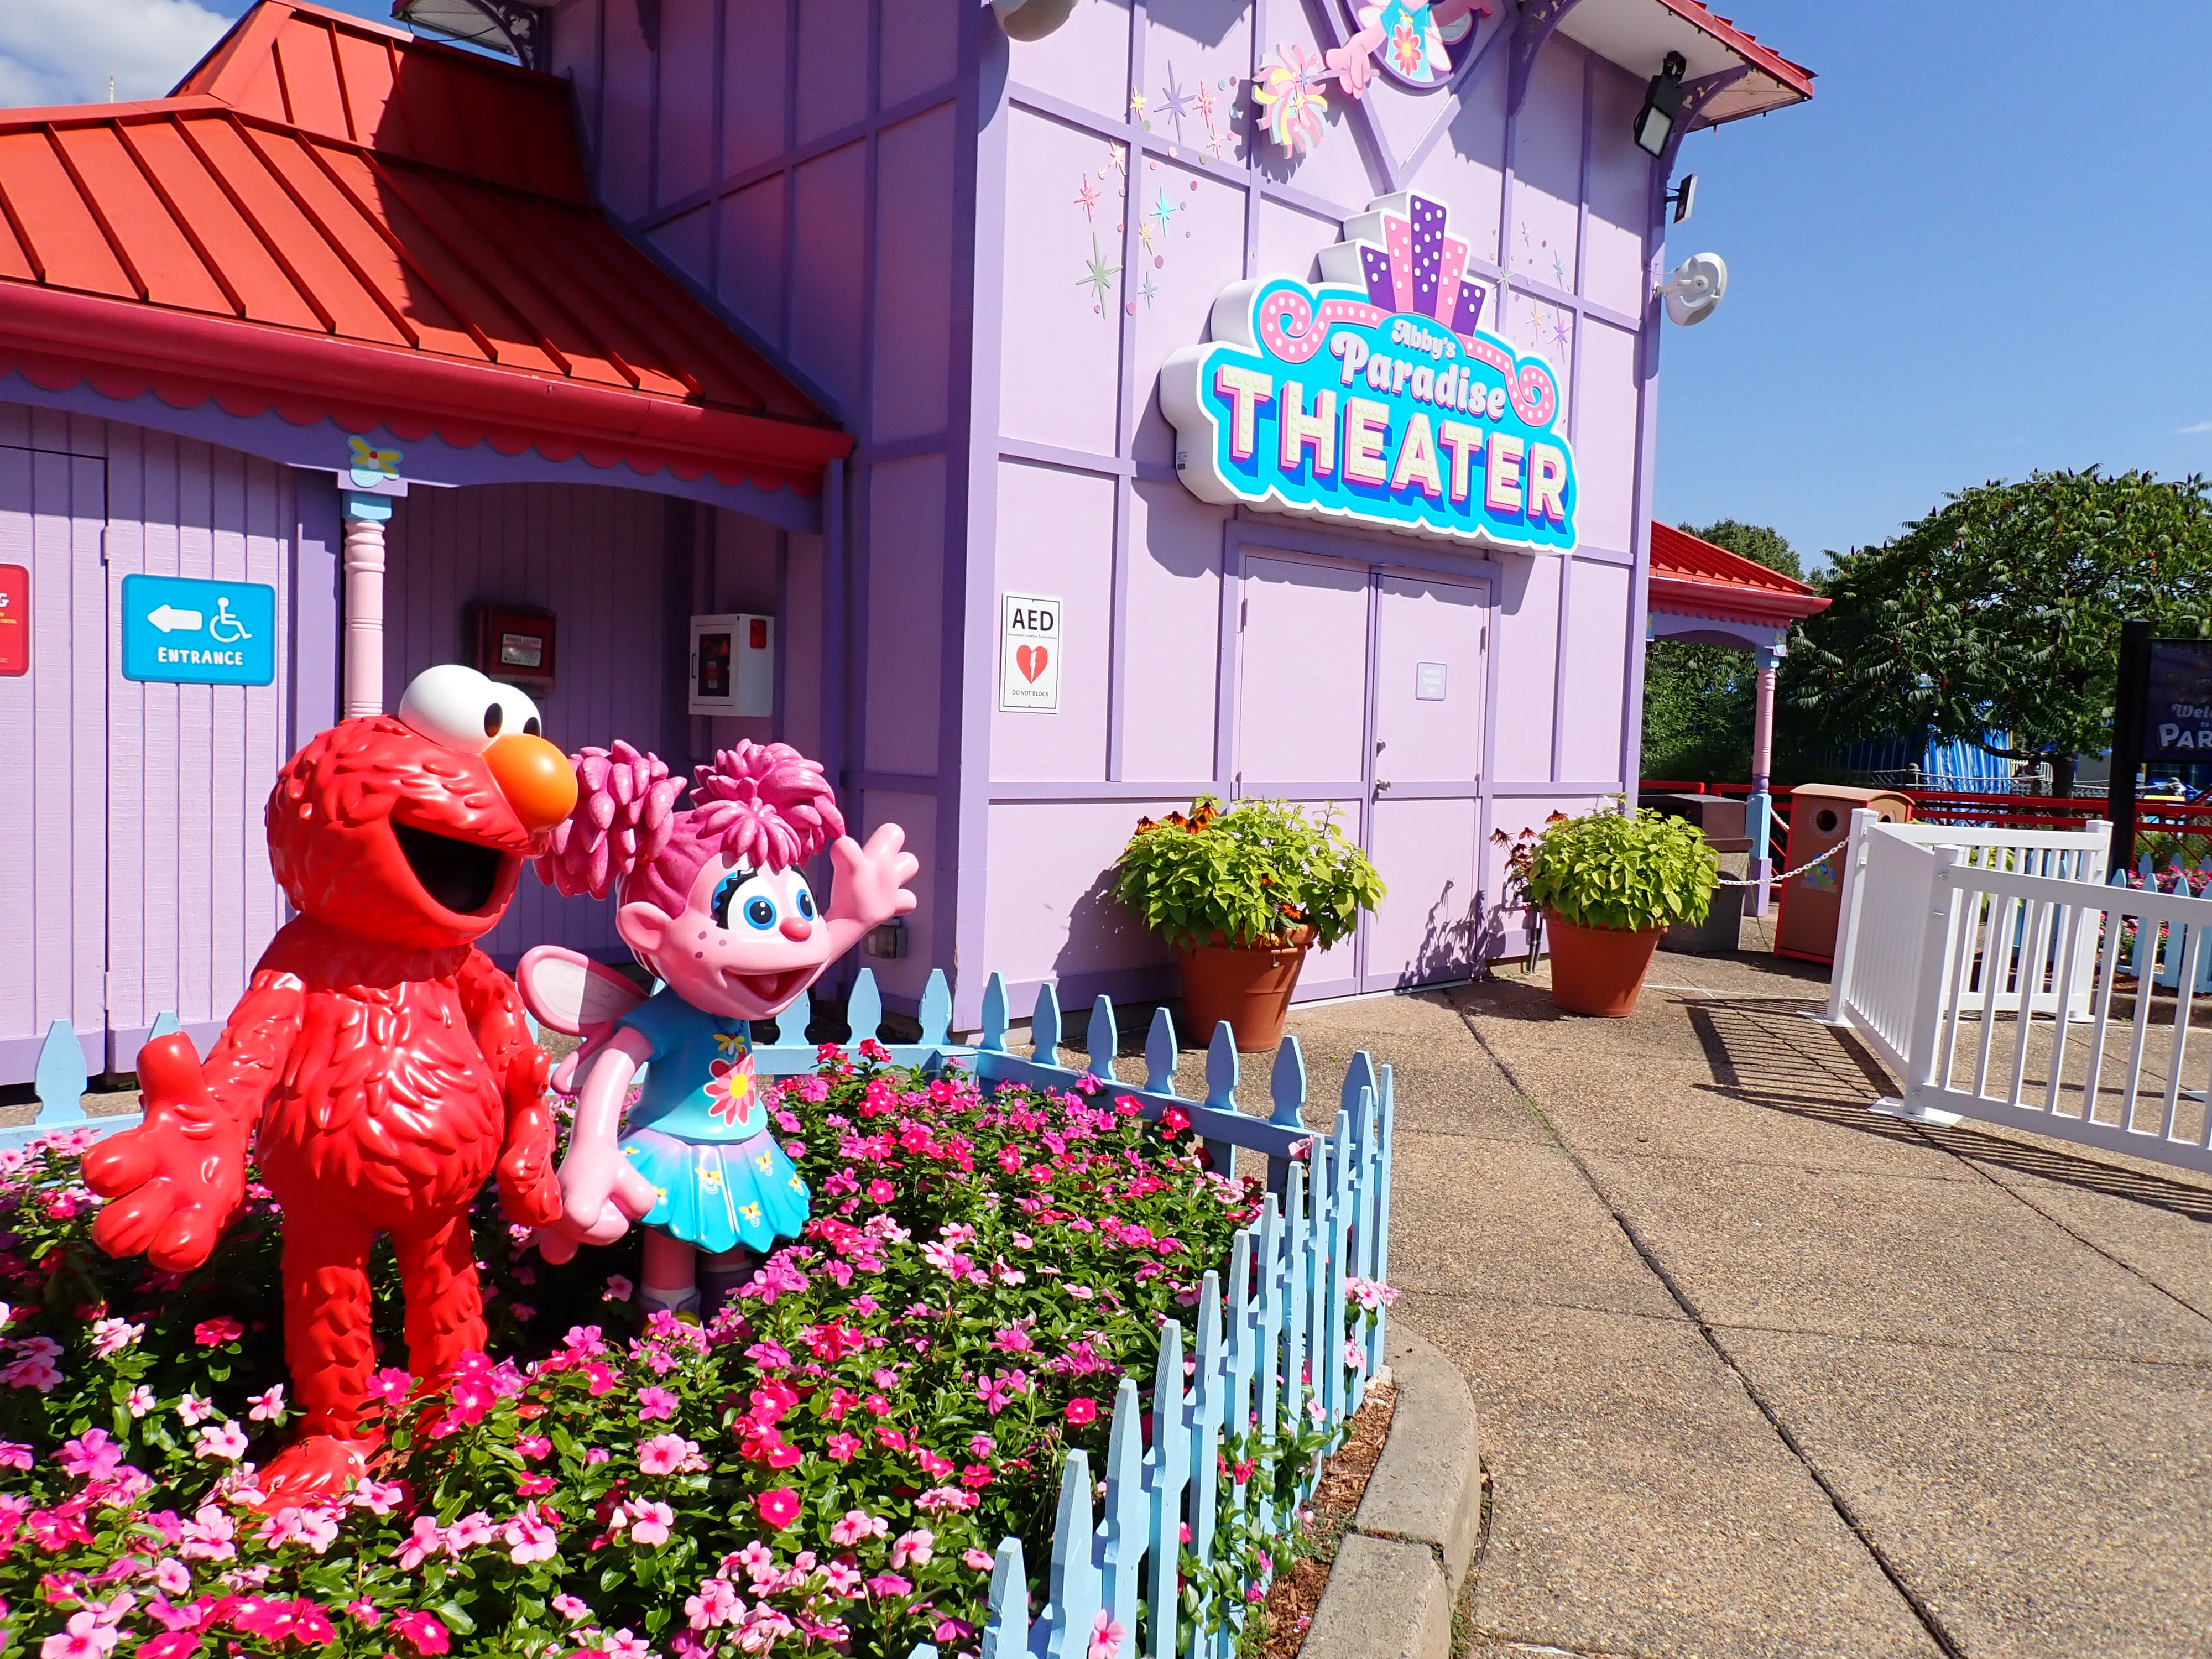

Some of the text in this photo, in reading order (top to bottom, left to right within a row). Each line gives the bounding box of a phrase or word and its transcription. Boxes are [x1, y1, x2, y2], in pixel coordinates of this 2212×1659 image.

[1391, 319, 1456, 361] Abby's
[1329, 331, 1506, 423] Paradise
[1215, 363, 1567, 526] THEATER
[1012, 608, 1054, 631] AED
[158, 646, 243, 665] ENTRANCE
[2158, 723, 2212, 749] PAR
